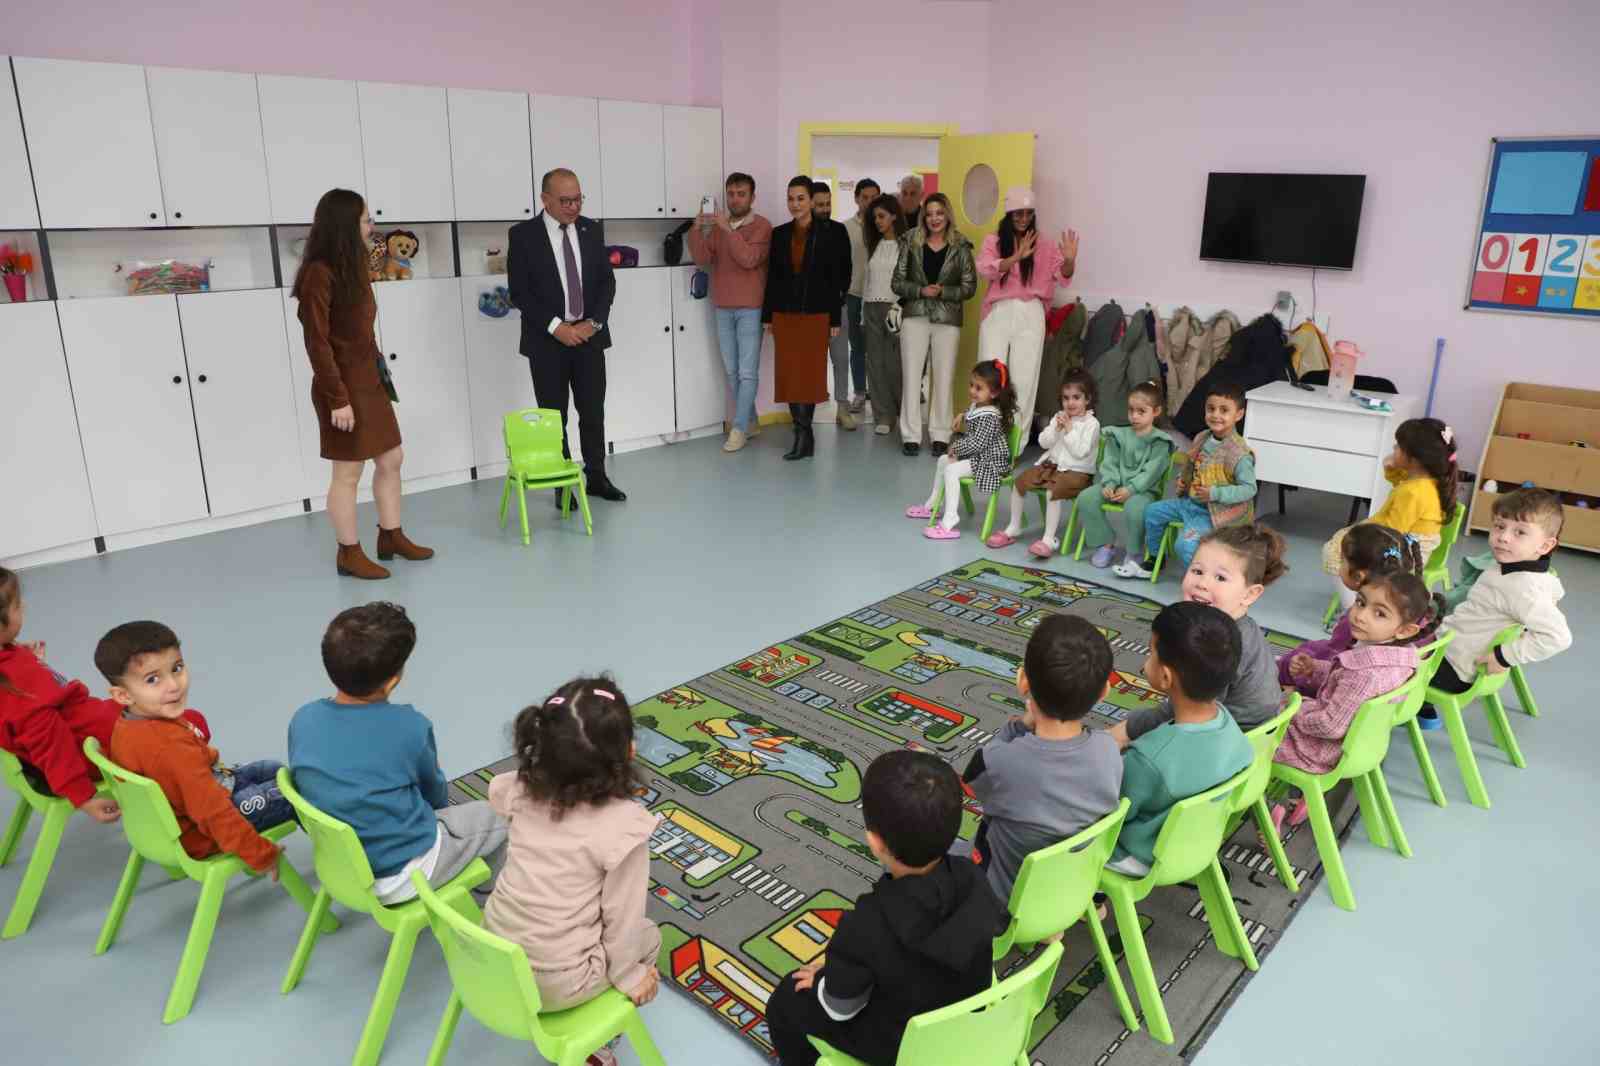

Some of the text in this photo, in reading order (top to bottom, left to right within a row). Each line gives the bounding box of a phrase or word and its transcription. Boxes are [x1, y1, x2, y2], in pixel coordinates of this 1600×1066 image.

[1482, 235, 1509, 270] 0
[1518, 237, 1539, 272] 1
[1550, 239, 1578, 273] 2
